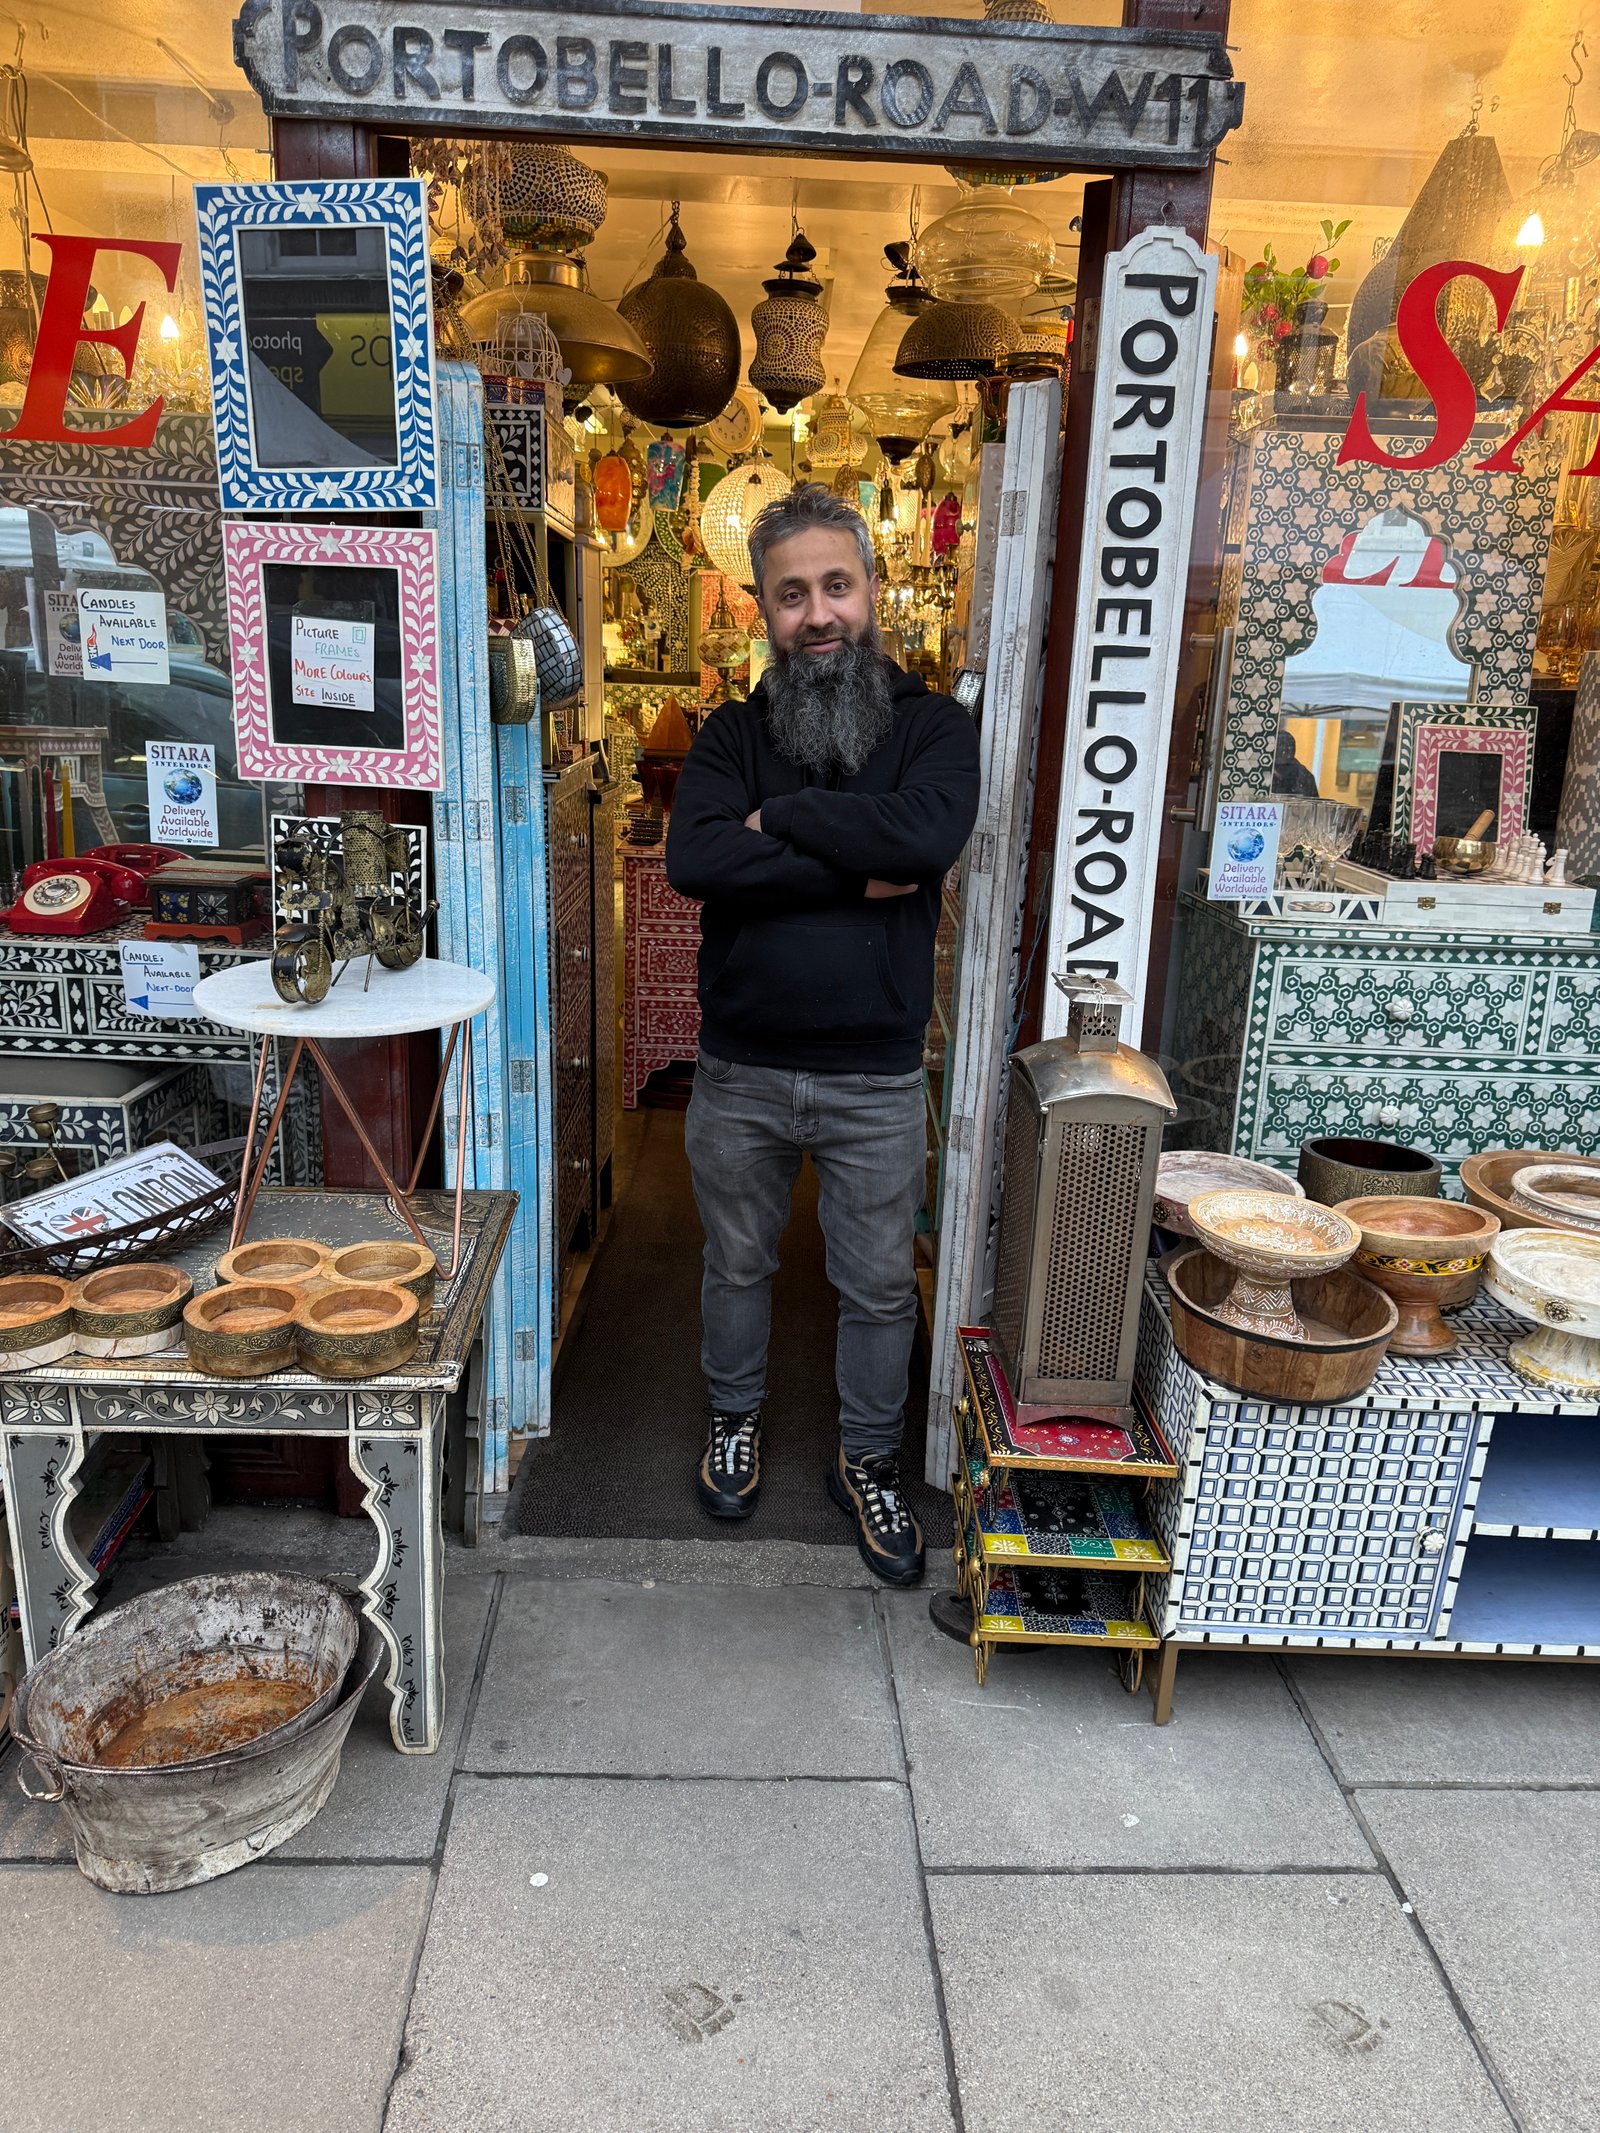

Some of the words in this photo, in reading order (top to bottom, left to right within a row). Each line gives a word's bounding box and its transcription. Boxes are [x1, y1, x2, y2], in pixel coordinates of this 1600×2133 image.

[0, 232, 182, 448] E
[80, 591, 136, 609] CANDLES
[99, 614, 157, 629] AVAILABLE
[295, 618, 340, 640] PICTURE
[111, 635, 135, 647] NEXT
[139, 638, 166, 650] DOOR
[315, 641, 361, 658] FRAMES
[294, 658, 327, 679] MORE
[295, 684, 316, 697] SIZE
[321, 687, 356, 703] INSIDE
[151, 744, 212, 762] SITARA
[163, 804, 206, 818] Delivery
[1220, 805, 1278, 820] SITARA
[160, 815, 210, 828] Available
[157, 825, 214, 838] Worldwide
[1223, 863, 1265, 873] Delivery
[1218, 873, 1266, 883] Available
[1214, 883, 1268, 894] Worldwide
[143, 965, 191, 978] AVAILABLE
[92, 1166, 216, 1225] LONDON
